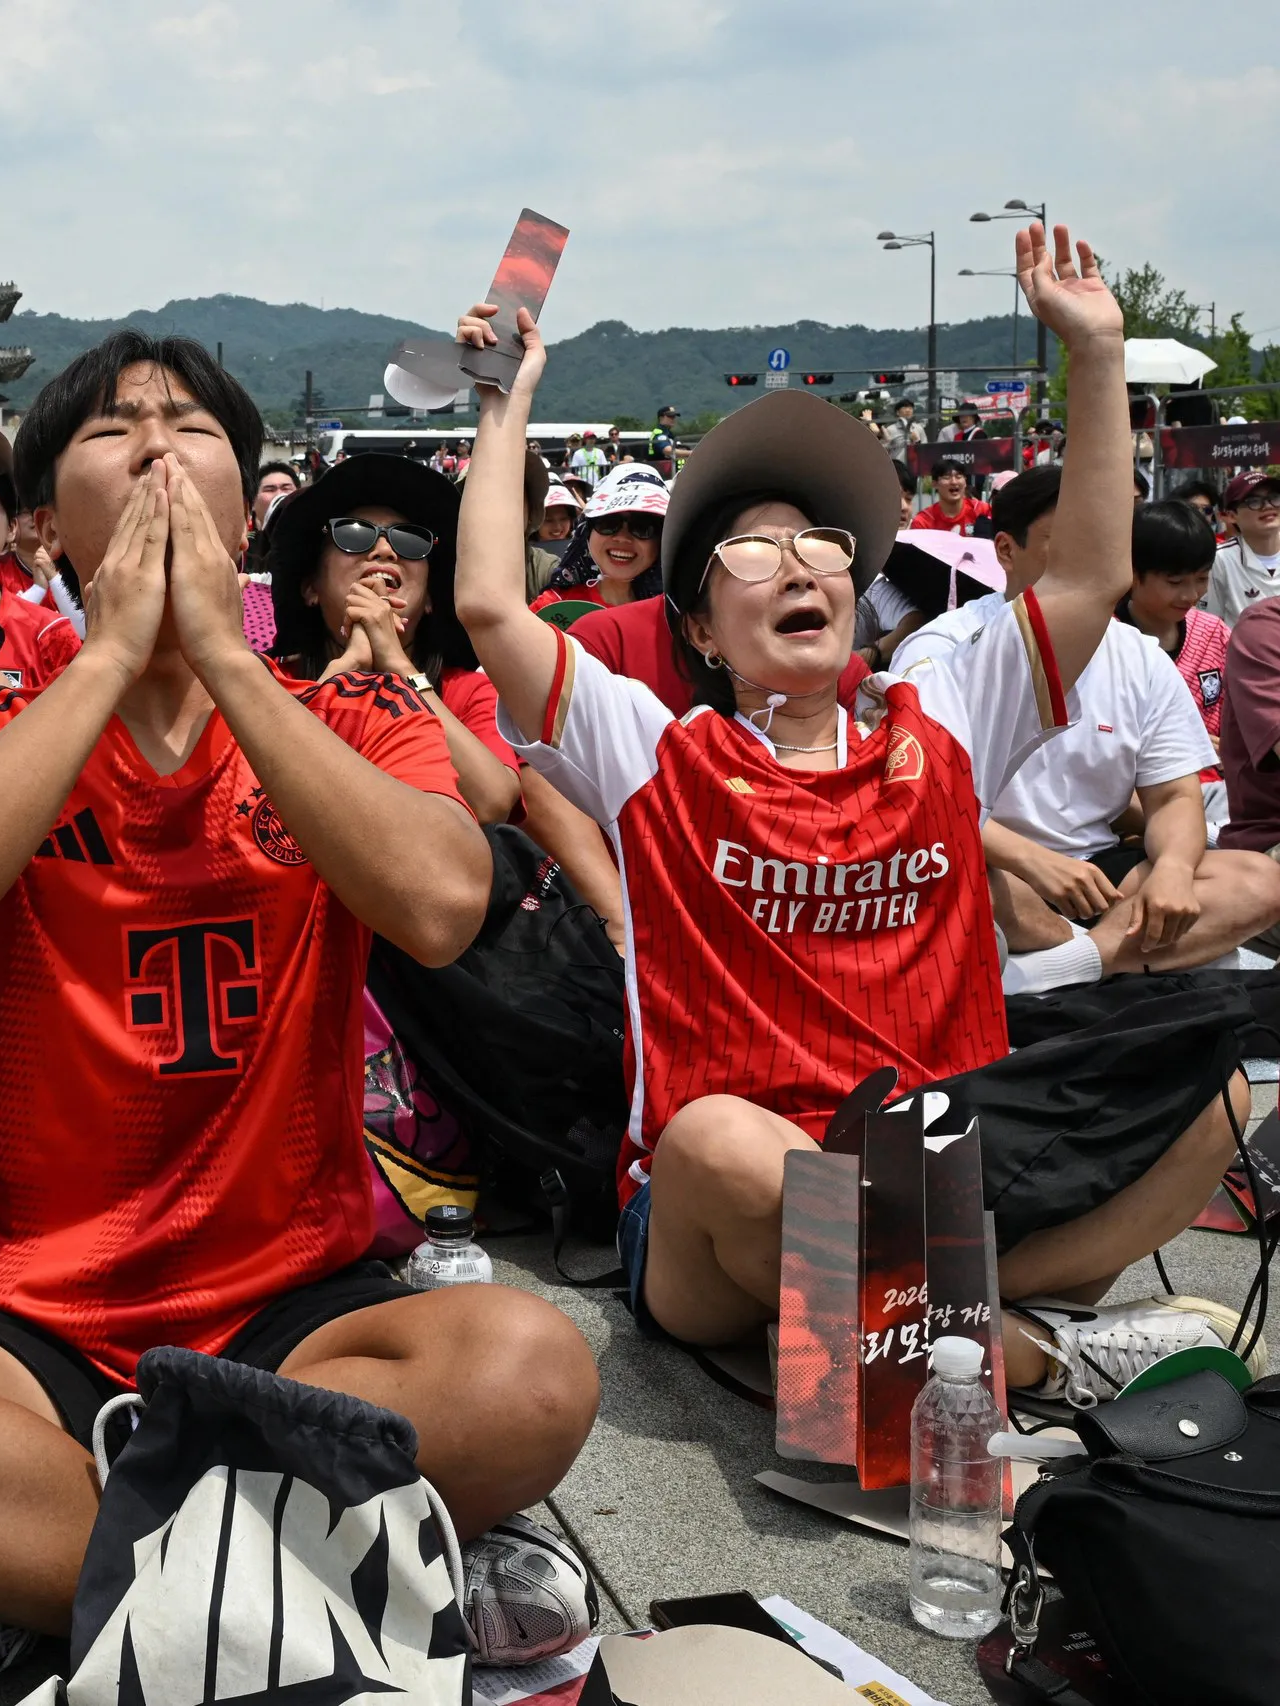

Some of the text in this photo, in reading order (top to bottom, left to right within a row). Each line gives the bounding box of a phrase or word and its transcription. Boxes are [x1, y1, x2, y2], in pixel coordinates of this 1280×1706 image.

[263, 838, 303, 861] MÜNC
[713, 837, 951, 897] Emirates
[751, 891, 919, 934] FLY BETTER
[121, 913, 263, 1080] T
[882, 1281, 928, 1314] 2026
[67, 1464, 470, 1706] NIKE
